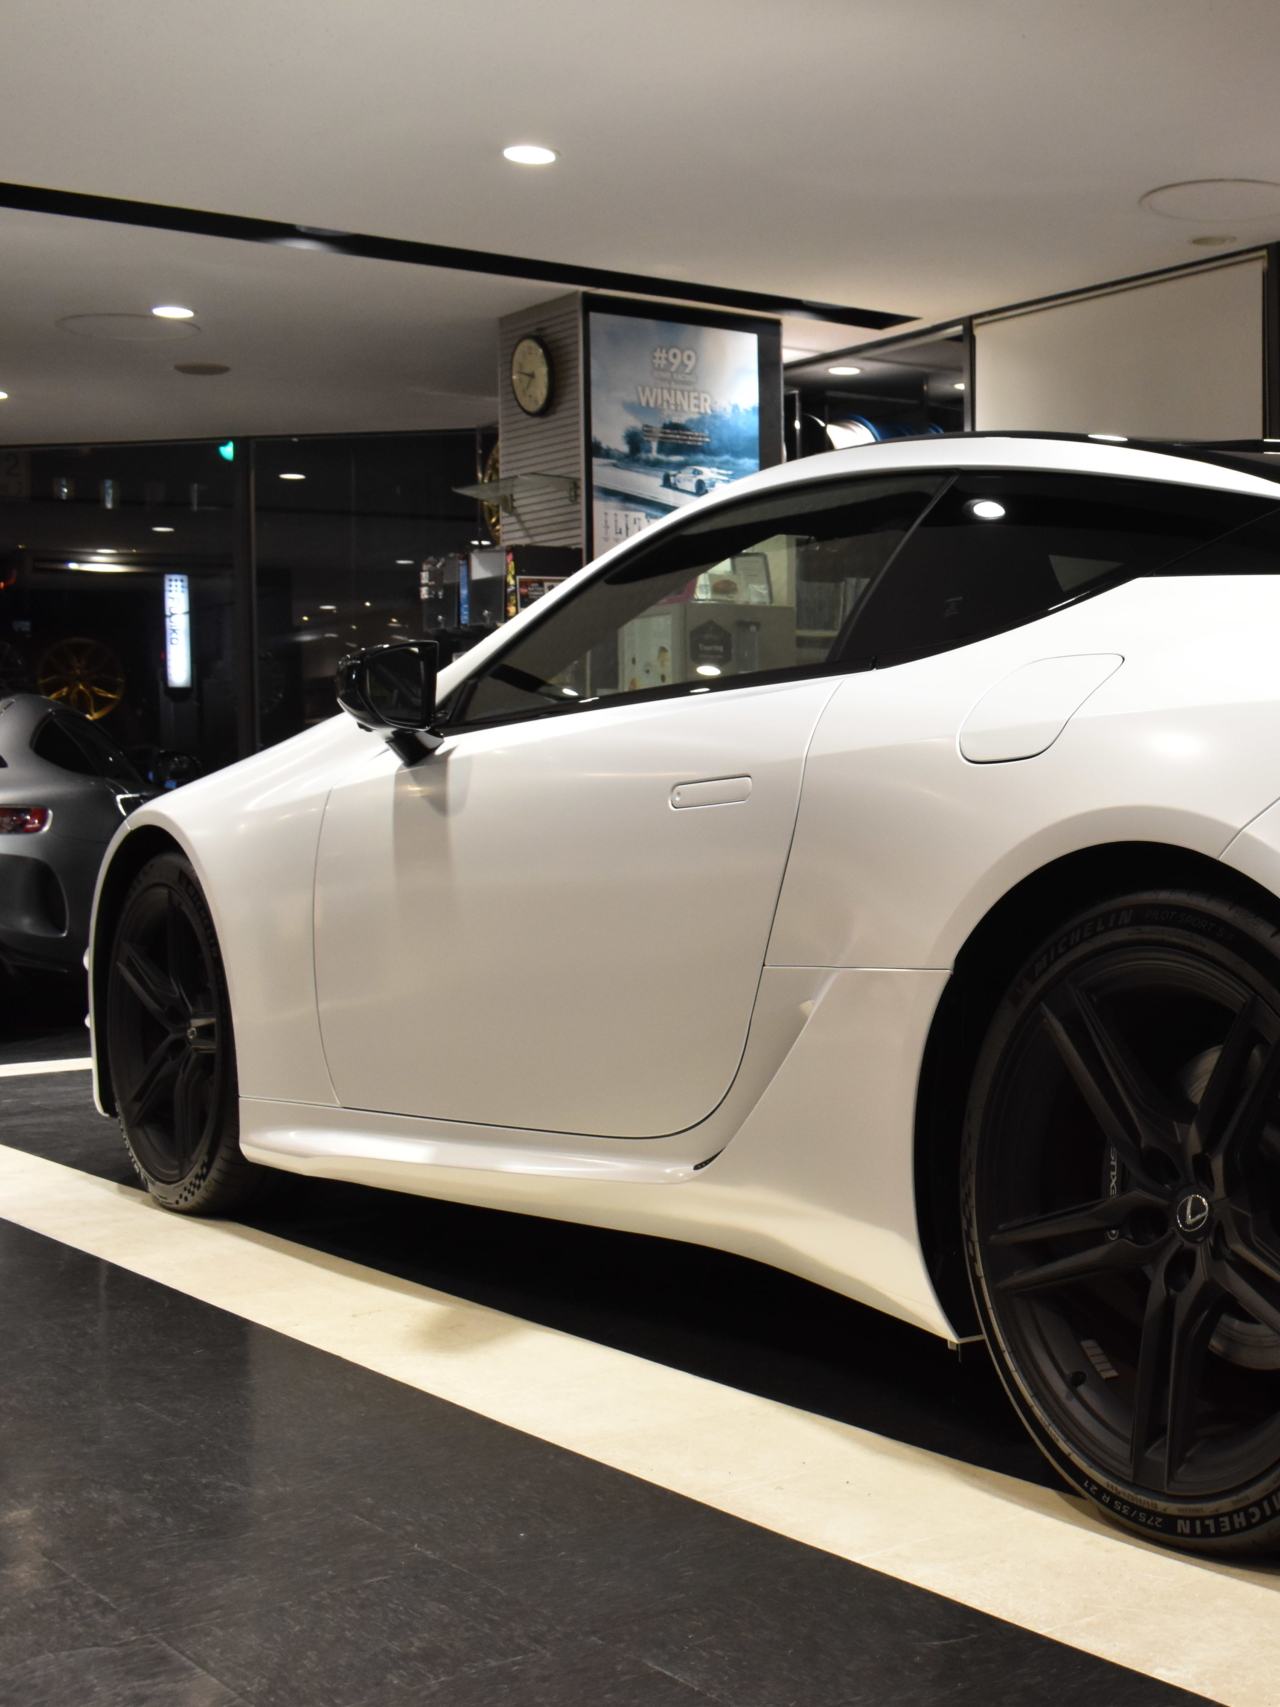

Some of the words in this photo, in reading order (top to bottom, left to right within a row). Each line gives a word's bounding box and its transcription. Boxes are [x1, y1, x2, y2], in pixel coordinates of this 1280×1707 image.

[653, 347, 696, 373] #99
[636, 386, 712, 414] WINNER
[1032, 908, 1135, 977] MICHELIN
[1144, 908, 1177, 921] PILOT
[1177, 912, 1216, 934] SPORT
[1082, 1479, 1099, 1494] 21
[1101, 1494, 1111, 1504] R
[1113, 1498, 1163, 1529] 275/35
